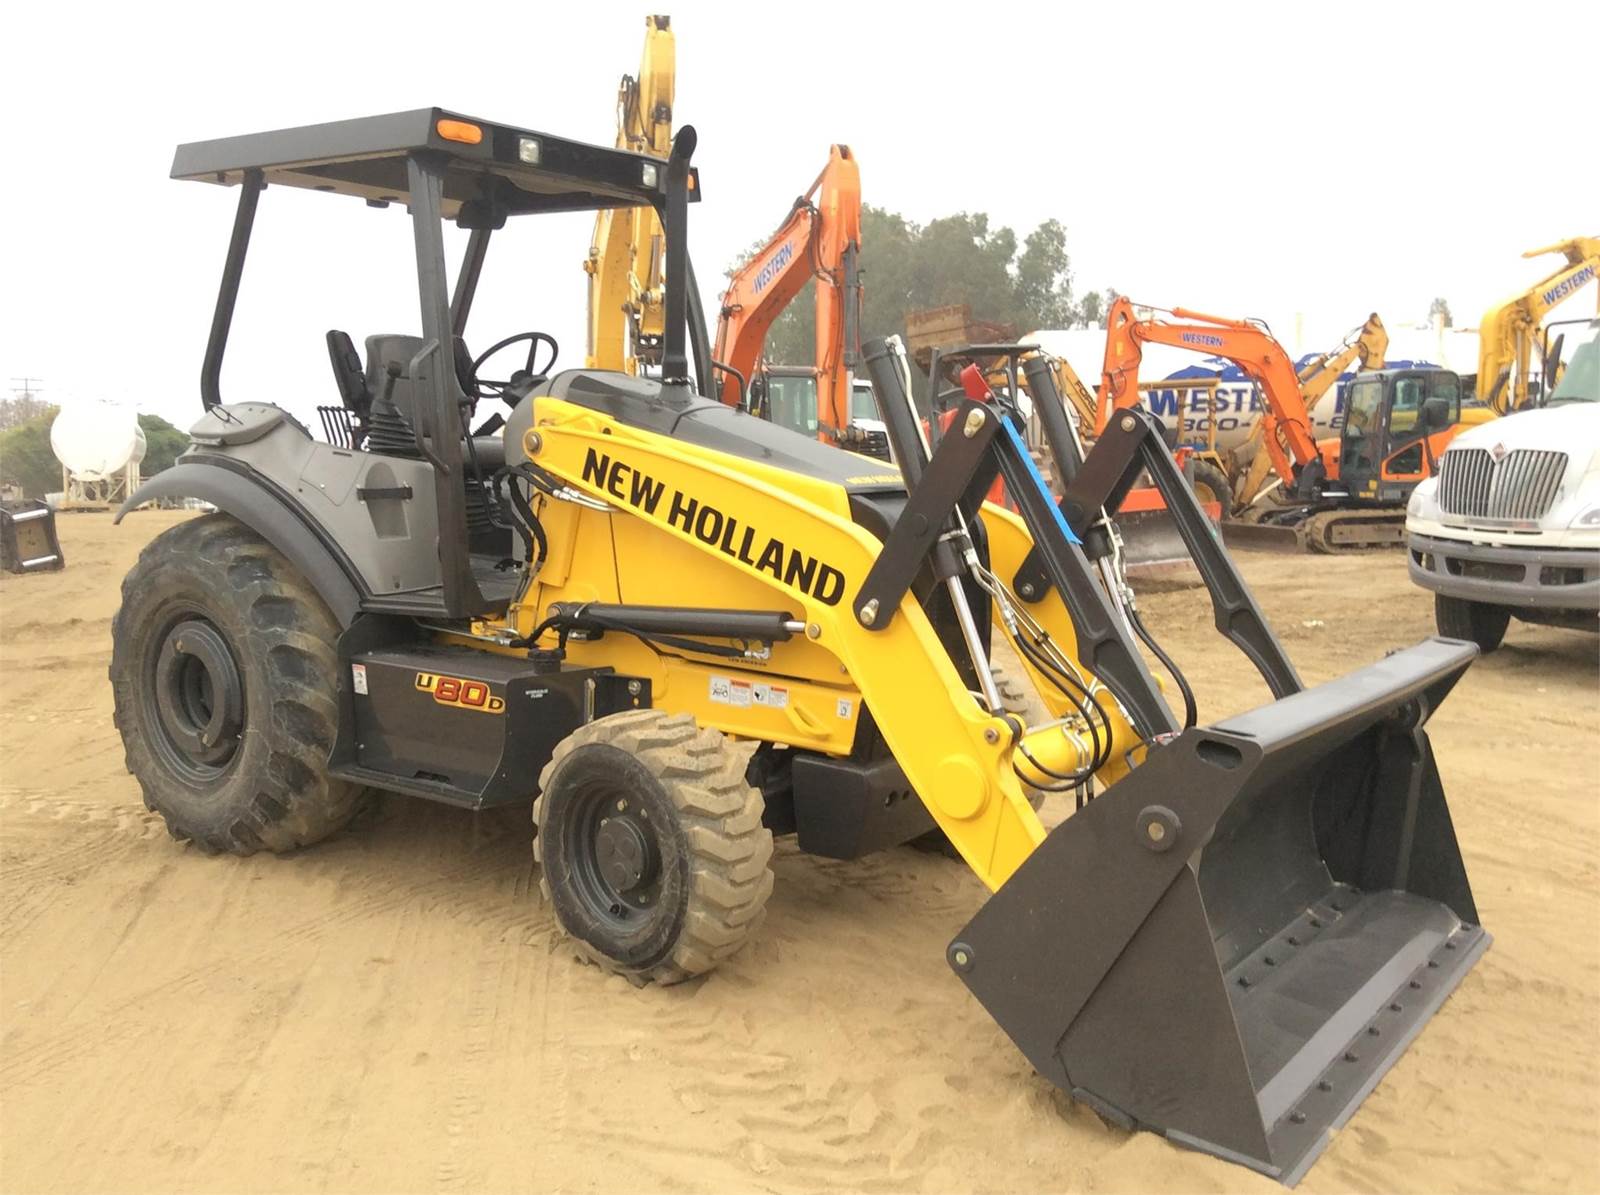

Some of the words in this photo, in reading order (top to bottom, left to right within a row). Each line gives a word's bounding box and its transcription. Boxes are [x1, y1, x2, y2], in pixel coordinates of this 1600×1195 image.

[752, 240, 793, 294] WESTERN
[1543, 264, 1595, 305] WESTERN
[1182, 332, 1223, 347] WESTERN
[582, 447, 665, 516] NEW
[666, 490, 846, 607] HOLLAND
